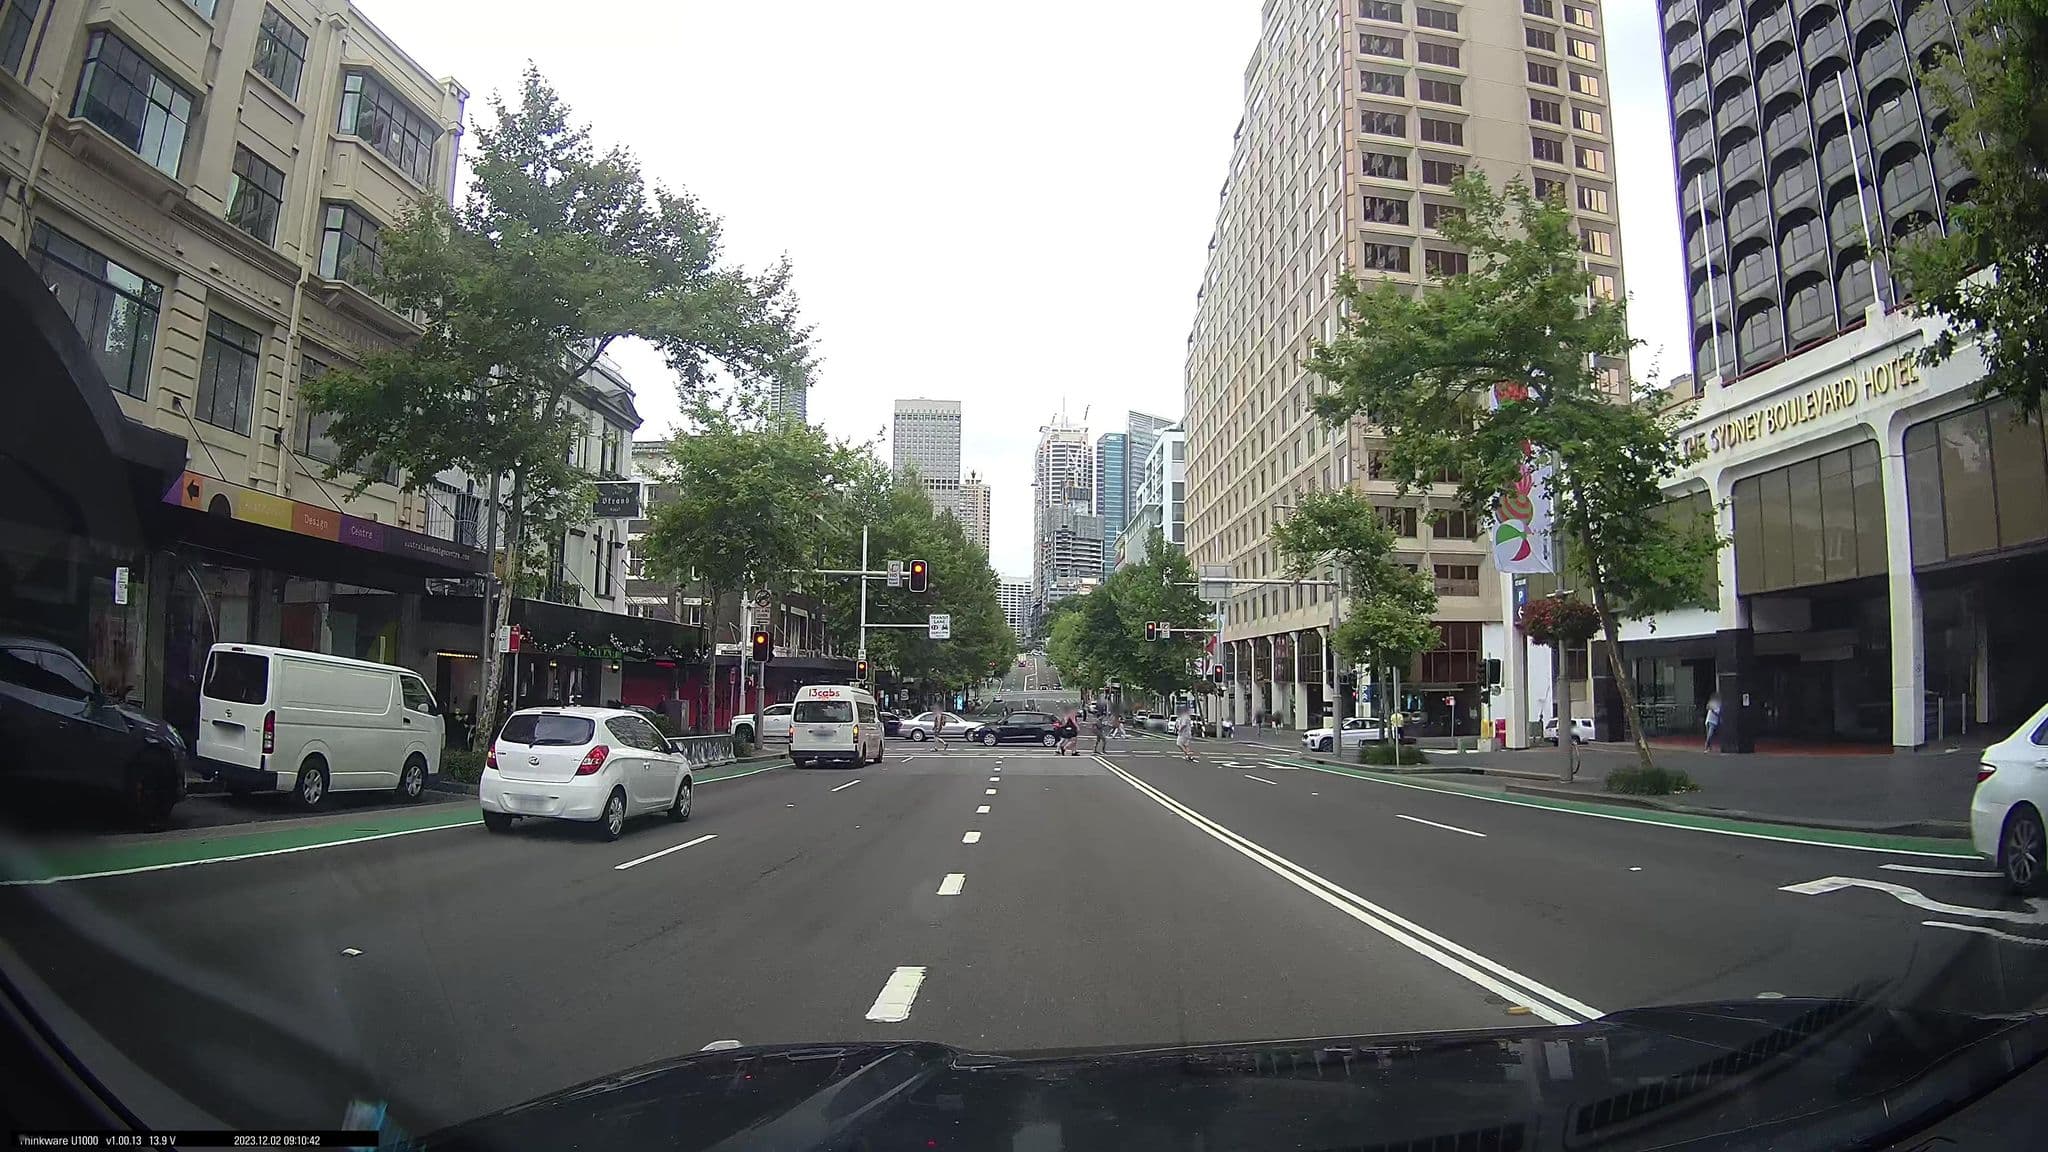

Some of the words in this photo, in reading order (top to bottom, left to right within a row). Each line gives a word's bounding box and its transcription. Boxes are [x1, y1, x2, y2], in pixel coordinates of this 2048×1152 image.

[1710, 410, 1765, 453] SYDNEY
[1767, 376, 1857, 434] BOULEVARD
[1862, 354, 1920, 401] HOTEL
[304, 513, 329, 530] Design
[1518, 590, 1524, 602] P
[808, 688, 840, 697] 13cabs
